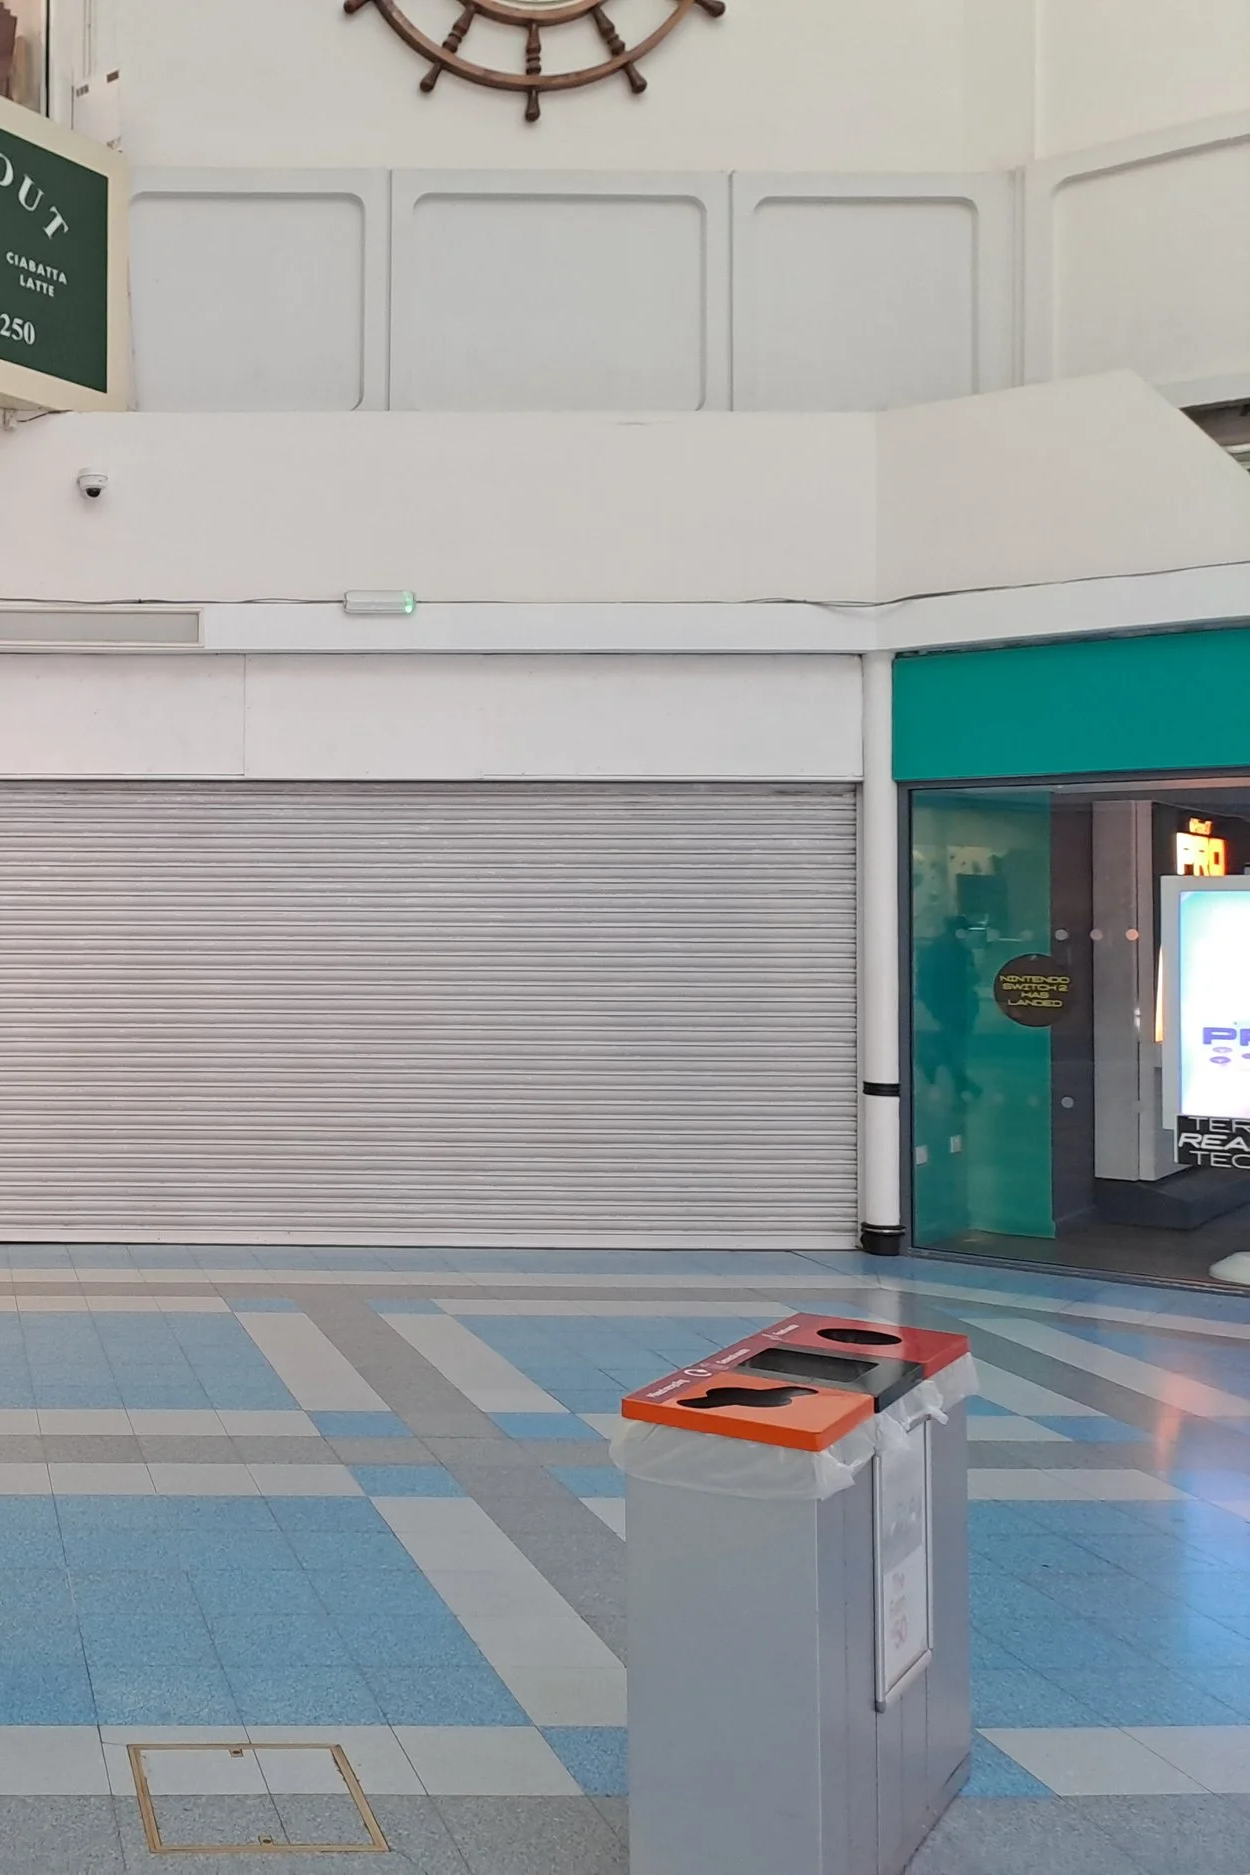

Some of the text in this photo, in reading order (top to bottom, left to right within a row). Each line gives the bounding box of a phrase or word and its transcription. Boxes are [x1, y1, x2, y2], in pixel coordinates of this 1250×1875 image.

[5, 251, 68, 285] CIABATTA
[19, 274, 55, 297] LATTE
[0, 313, 36, 345] 250
[999, 975, 1070, 984] NINTENDO
[1002, 983, 1057, 991] SWITCH
[1021, 991, 1050, 999] HAS
[1007, 999, 1063, 1008] LANDED
